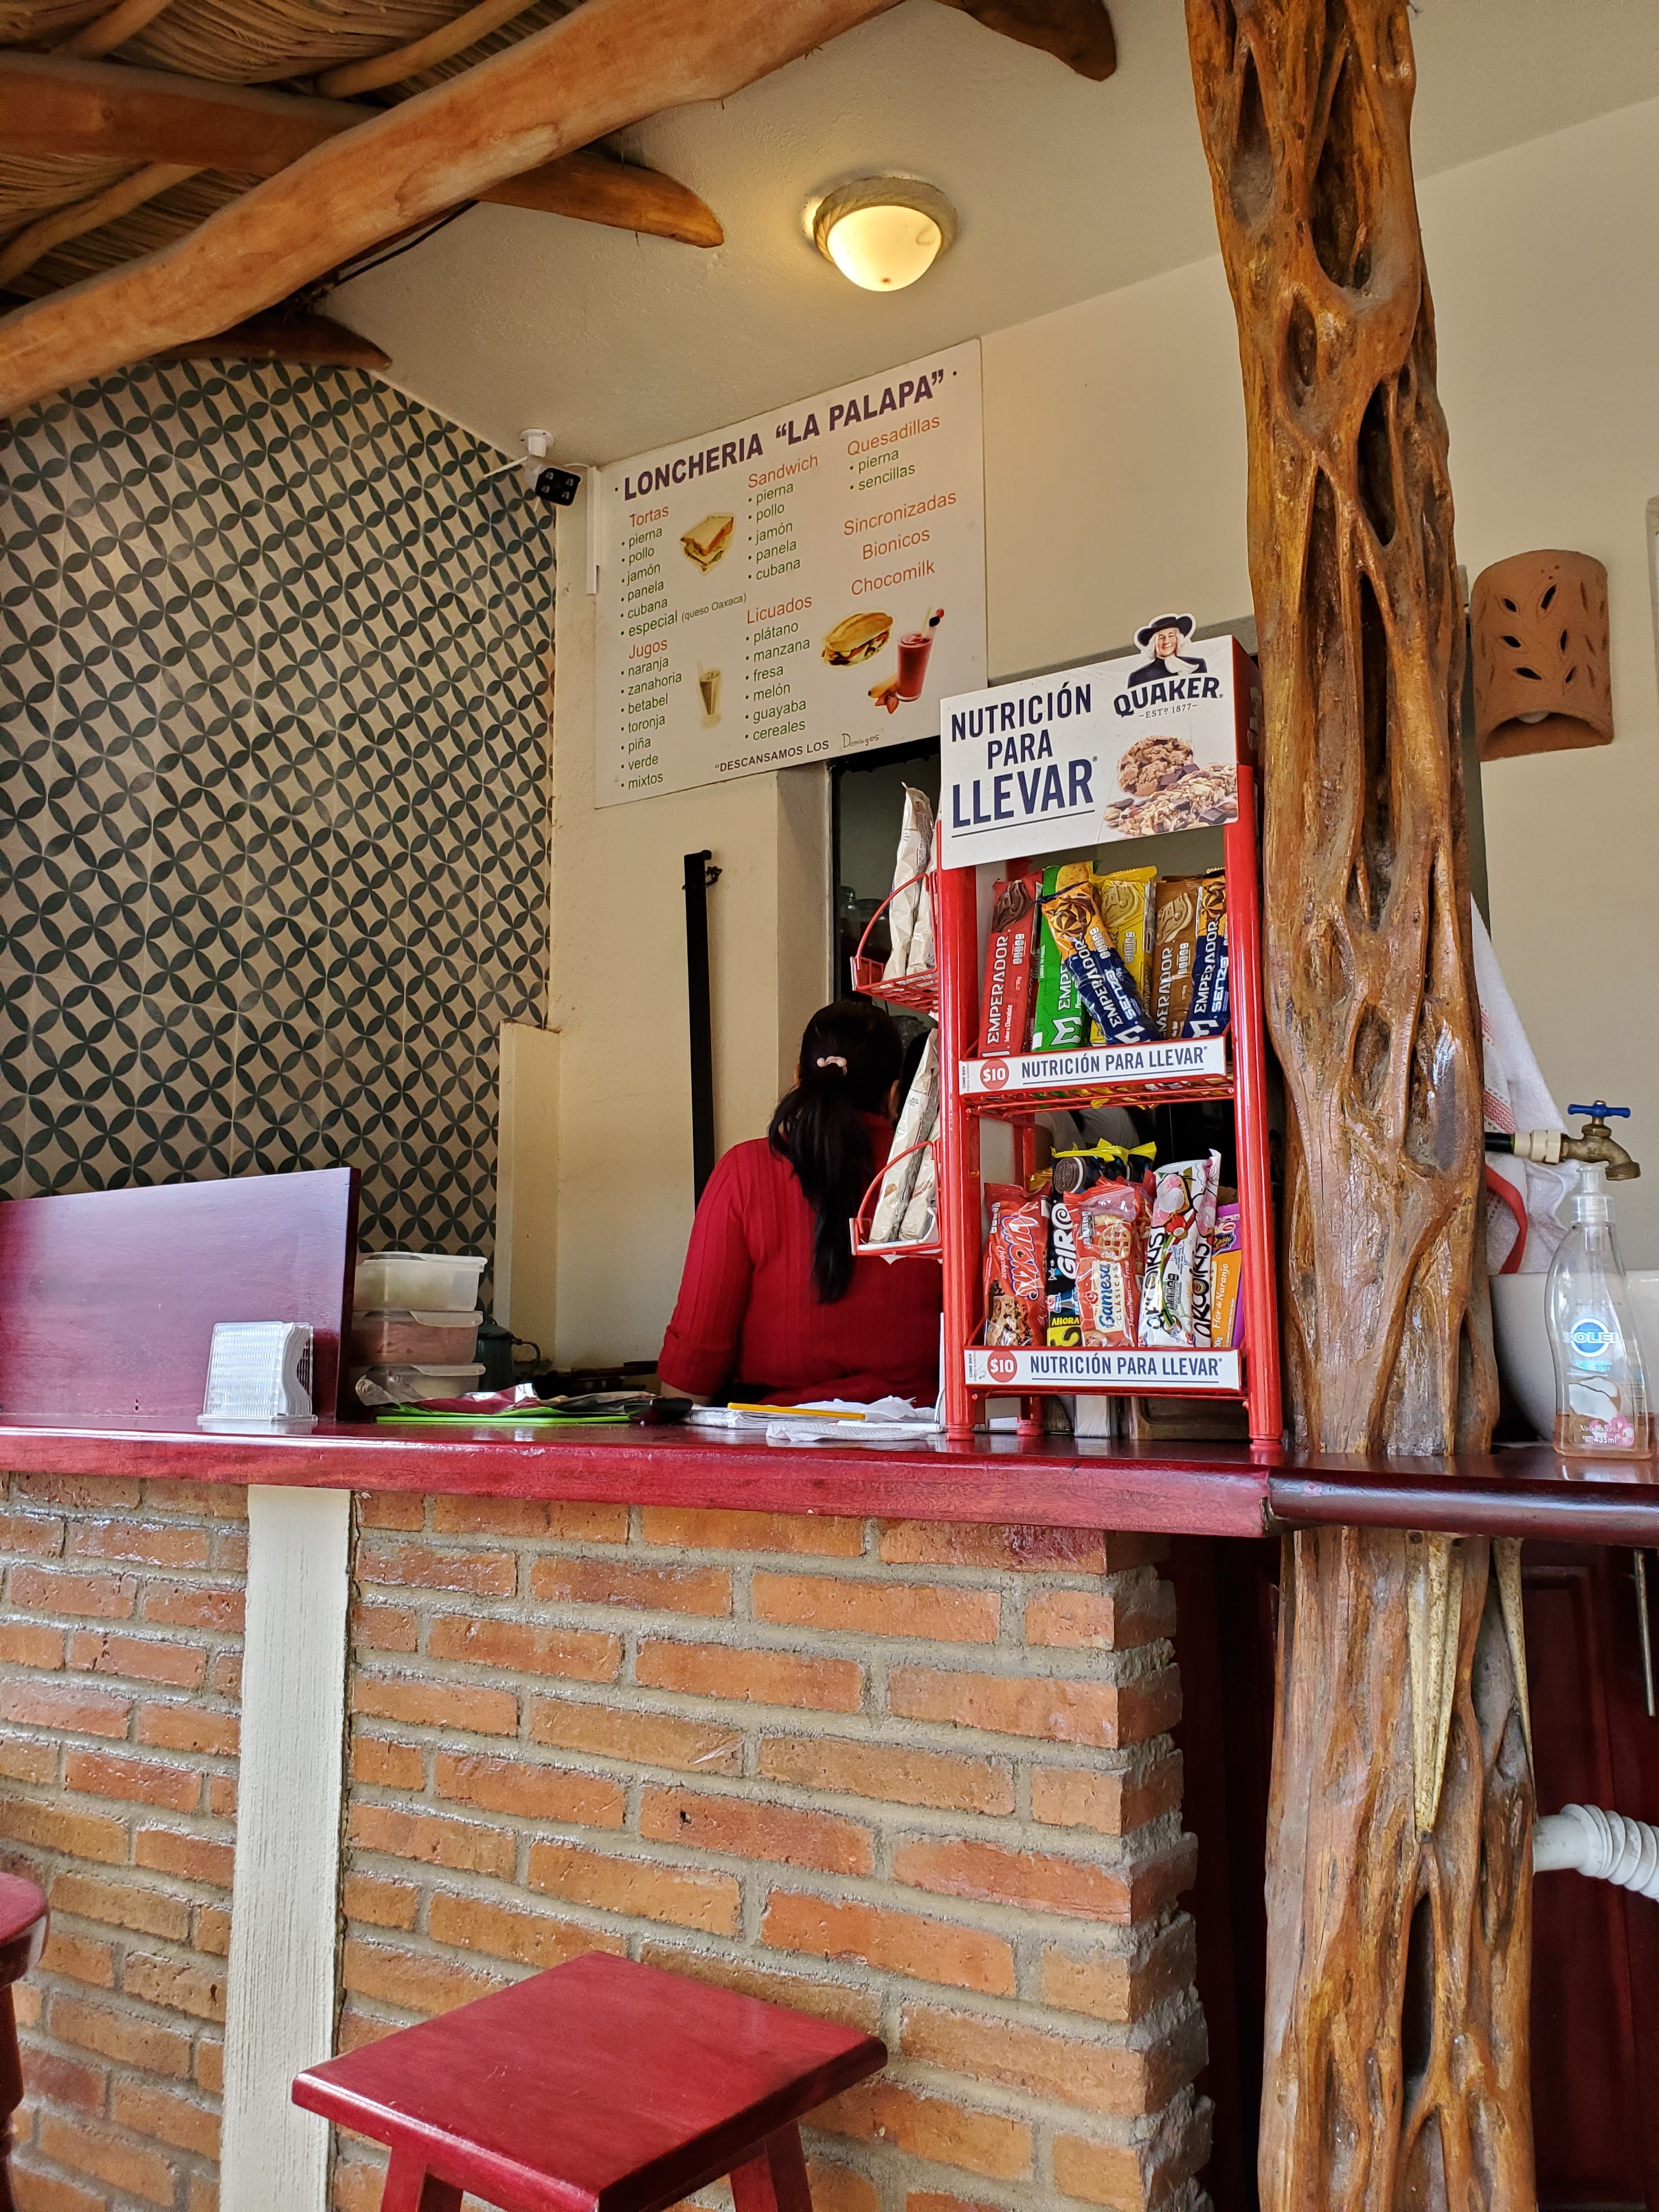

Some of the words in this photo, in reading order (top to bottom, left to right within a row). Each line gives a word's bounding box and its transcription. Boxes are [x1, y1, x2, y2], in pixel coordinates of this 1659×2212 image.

[848, 416, 940, 456] Quesadillas
[624, 433, 763, 500] LONCHERIA
[748, 454, 818, 488] Sandwich
[859, 449, 899, 474] pierna
[859, 463, 916, 490] sencillas
[757, 482, 793, 506] pierna
[629, 506, 669, 527] Tortas
[757, 503, 785, 523] pollo
[844, 492, 956, 536] Sincronizadas
[629, 528, 663, 549] pierna
[755, 522, 793, 545] jamón
[862, 529, 930, 560] Bionicos
[629, 546, 654, 566] pollo
[756, 540, 797, 563] panela
[627, 563, 661, 586] jamón
[756, 558, 800, 580] cubana
[851, 560, 935, 595] Chocomilk
[628, 580, 664, 602] panela
[628, 598, 668, 619] cubana
[747, 596, 812, 624] Licuados
[629, 610, 678, 636] especial
[754, 622, 799, 645] plátano
[629, 639, 668, 659] Jugos
[754, 639, 810, 662] manzana
[628, 657, 669, 677] naranja
[754, 665, 783, 683] fresa
[628, 672, 682, 696] zanahoria
[753, 683, 791, 702] melón
[629, 693, 668, 714] betabel
[1114, 676, 1218, 718] QUAKER
[753, 699, 806, 724] guayaba
[952, 681, 1091, 742] NUTRICIÓN
[629, 714, 665, 733] toronja
[753, 720, 805, 741] cereales
[629, 737, 651, 755] piña
[807, 740, 829, 753] LOS
[840, 733, 879, 749] Domingos
[988, 729, 1053, 769] PARA
[628, 754, 658, 770] verde
[629, 772, 663, 789] mixtos
[1194, 921, 1218, 1014] EMPERADOR
[987, 934, 1009, 1044] EMPERADOR
[1075, 939, 1124, 1028] EMPERADOR
[1022, 1053, 1098, 1078] NUTRICIÓN
[1105, 1051, 1144, 1071] PARA
[1149, 1047, 1204, 1068] LLEVAR
[983, 1068, 1006, 1083] $10
[1216, 1263, 1230, 1301] Naranjo
[1098, 1263, 1115, 1328] Gamesa
[1052, 1317, 1080, 1326] AHORA
[1212, 1310, 1222, 1328] Flor
[990, 1357, 1014, 1374] $10
[1030, 1353, 1111, 1374] NUTRICIÓN
[1117, 1356, 1158, 1375] PARA
[1162, 1356, 1218, 1376] LLEVAR
